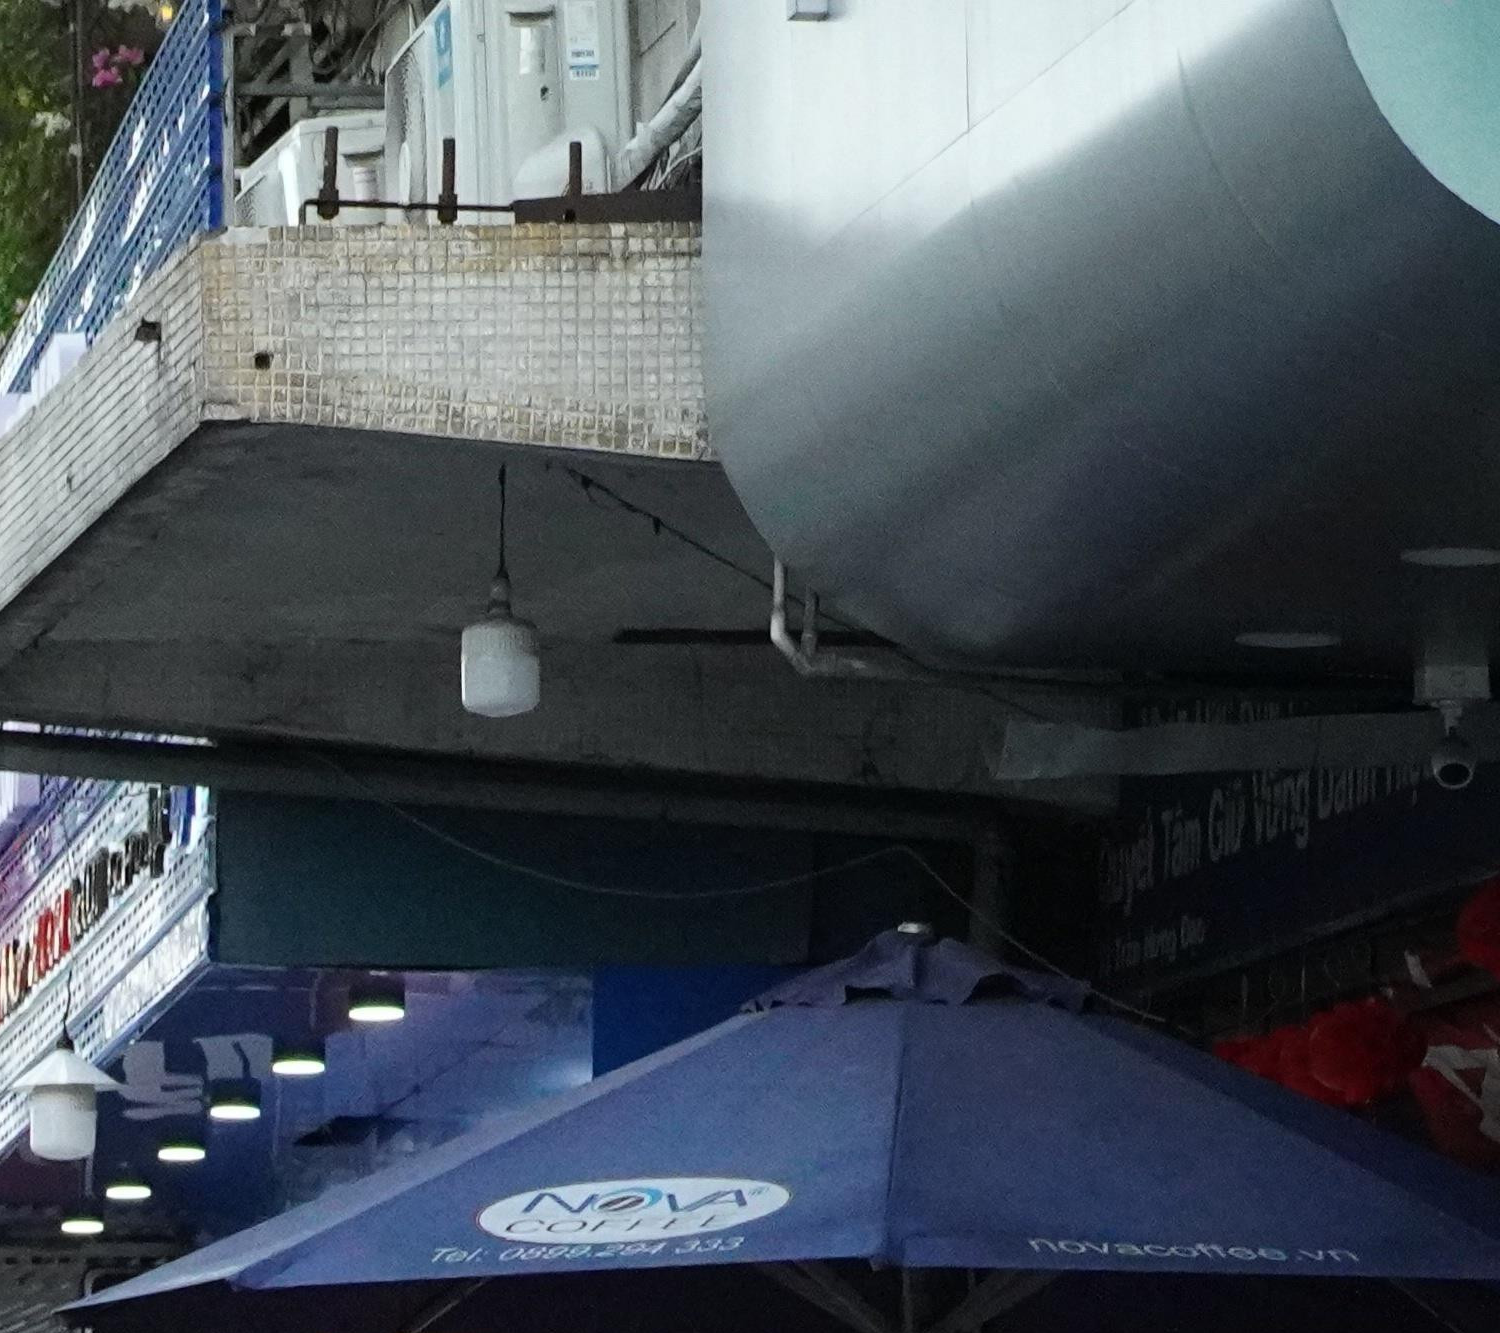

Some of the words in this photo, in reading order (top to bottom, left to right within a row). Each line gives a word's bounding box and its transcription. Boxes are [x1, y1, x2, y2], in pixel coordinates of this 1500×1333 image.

[522, 1185, 750, 1215] NOVA
[503, 1213, 734, 1235] COFFEE
[1028, 1235, 1360, 1265] novacoffee.vn
